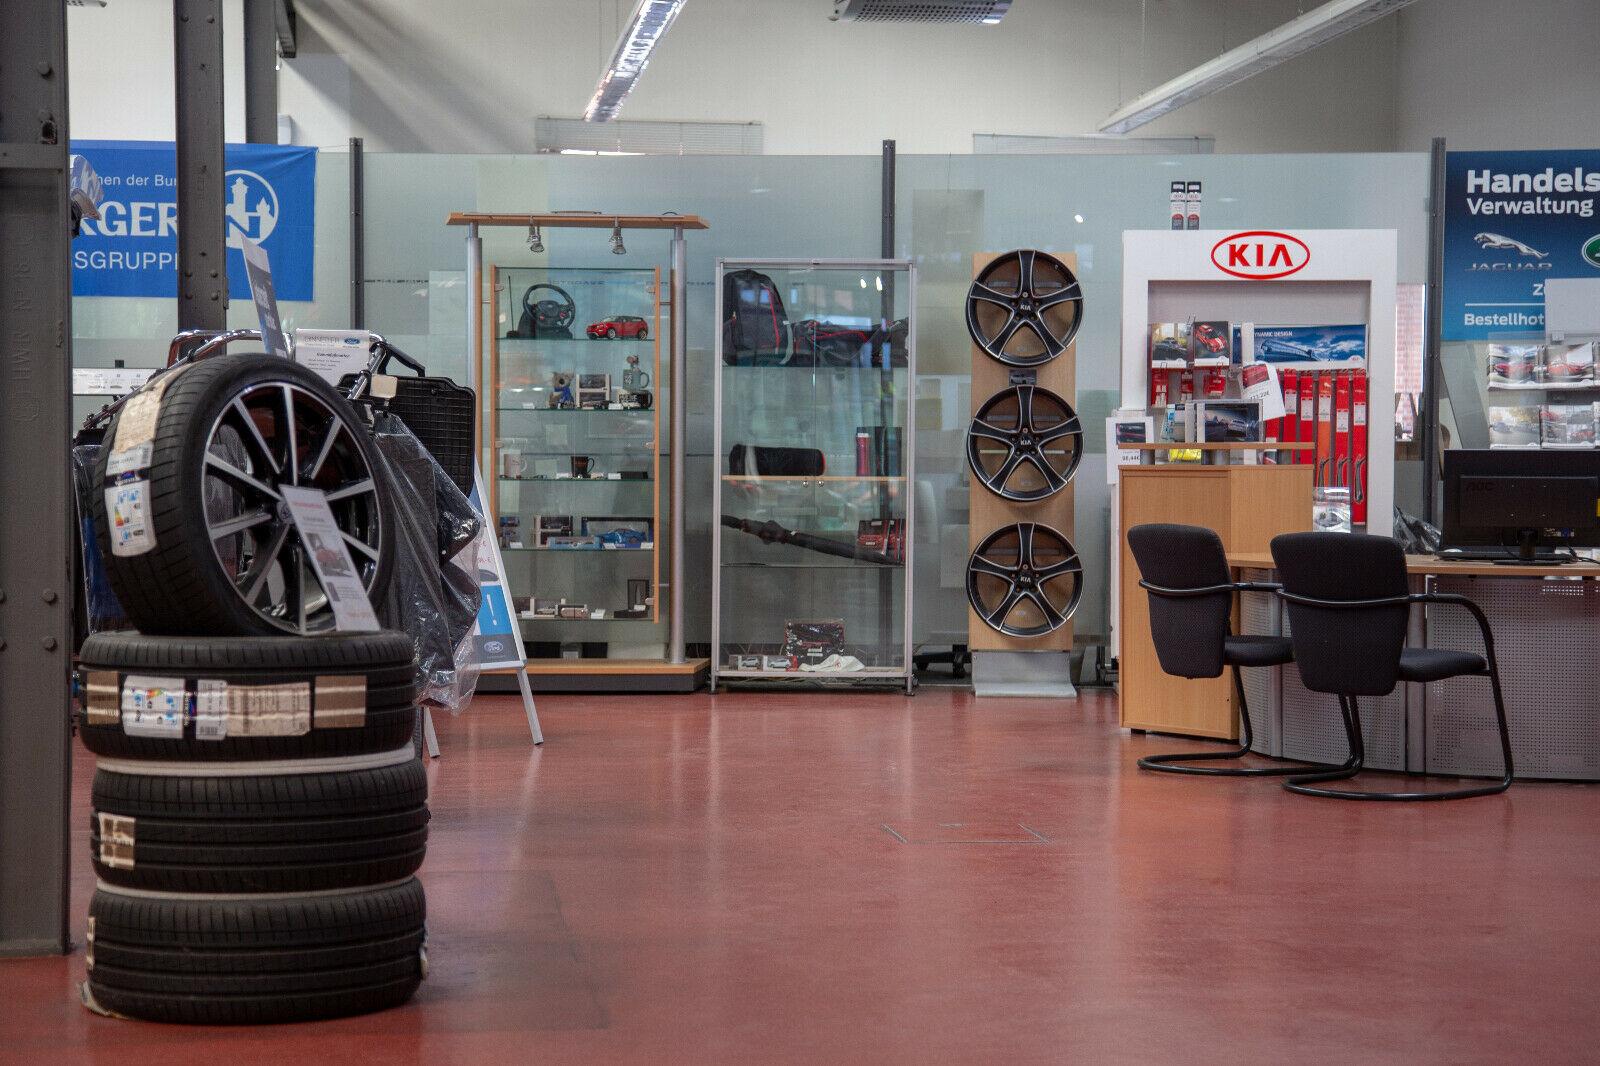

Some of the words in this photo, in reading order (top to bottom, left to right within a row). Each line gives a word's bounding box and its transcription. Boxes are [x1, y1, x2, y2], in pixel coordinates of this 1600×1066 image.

[126, 174, 149, 186] der
[1467, 167, 1600, 194] Handels
[1466, 196, 1594, 218] Verwaltung
[74, 250, 177, 270] SGRUPP
[1228, 243, 1294, 267] KIA
[1464, 262, 1553, 272] JAGUAR
